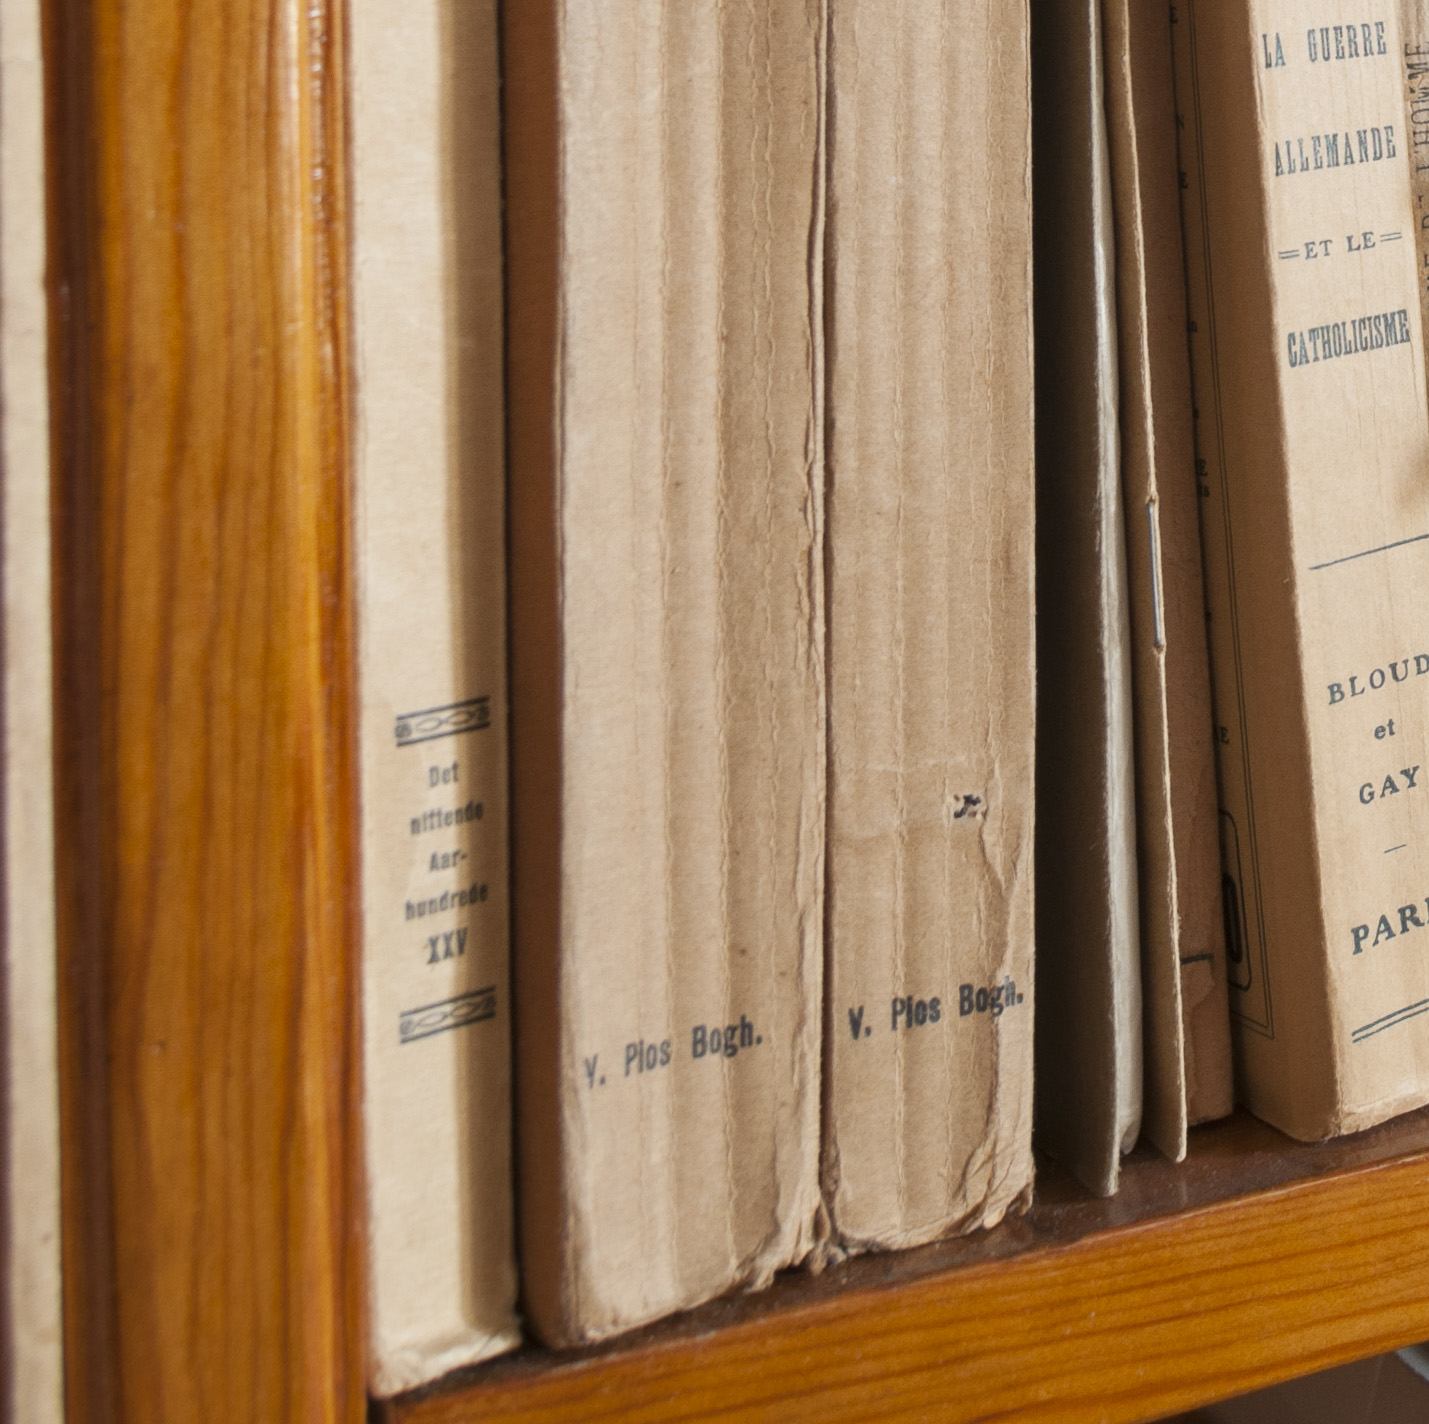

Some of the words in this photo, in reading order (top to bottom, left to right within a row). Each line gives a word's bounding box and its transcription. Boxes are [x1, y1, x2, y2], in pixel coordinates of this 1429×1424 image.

[1262, 32, 1286, 69] LA
[1307, 21, 1387, 63] GUERRE
[1275, 126, 1397, 177] ALLEMANDE
[1304, 238, 1333, 260] ET
[1347, 231, 1376, 253] LE
[1287, 309, 1410, 368] CATHOLICISME
[1374, 719, 1396, 740] et
[429, 762, 459, 789] Det
[1359, 766, 1420, 806] GAY
[409, 800, 483, 836] nittende
[429, 848, 467, 873] Aar-
[405, 882, 489, 921] hundrede
[426, 928, 467, 964] XXV
[848, 1006, 871, 1040] V.
[958, 975, 1024, 1017] Bogh.
[584, 1054, 605, 1089] V.
[691, 1014, 763, 1059] Bogh.
